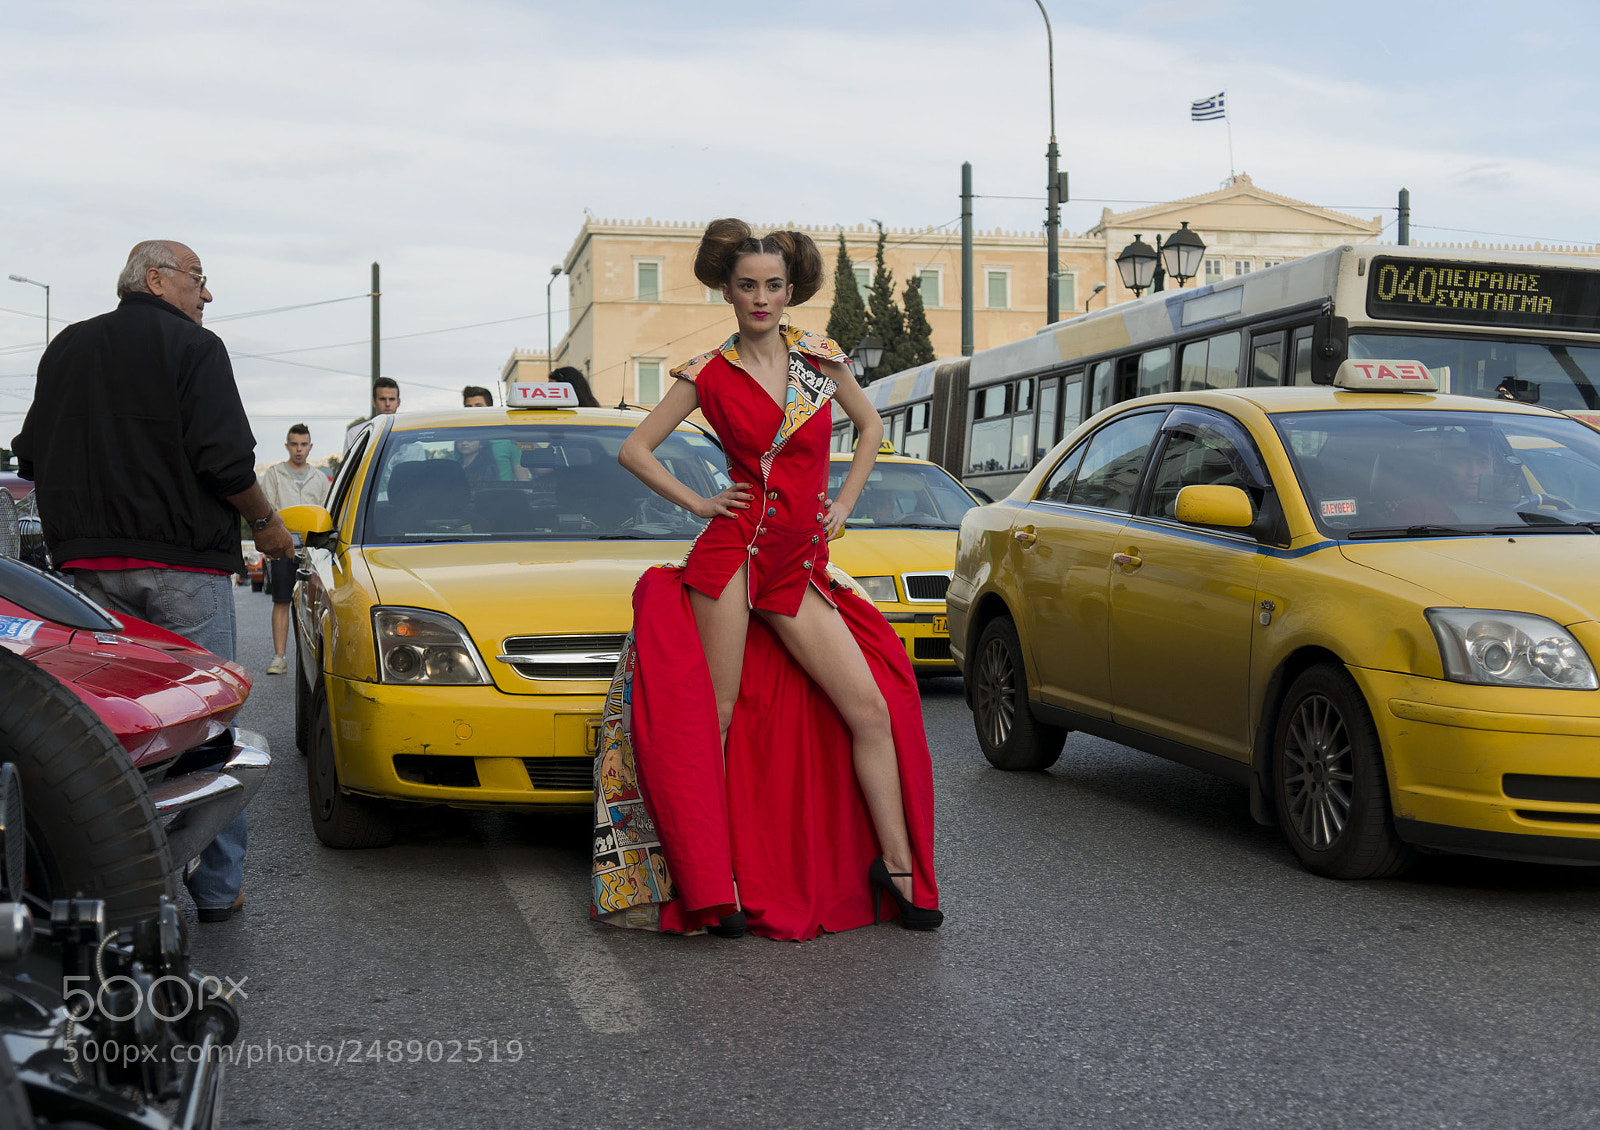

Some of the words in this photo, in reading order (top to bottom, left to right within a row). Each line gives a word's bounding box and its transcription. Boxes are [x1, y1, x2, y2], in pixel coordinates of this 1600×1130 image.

[1377, 264, 1438, 304] 040
[1437, 267, 1541, 293] ΠΕΙΡΑΙΑΣ
[1435, 289, 1553, 314] ΣΥΝΤΑΓΜΑ
[1354, 364, 1429, 381] ΤΑΞΙ
[517, 387, 569, 399] ΤΑΞΙ
[1321, 501, 1356, 515] ΕΛΕΥΘΕΡΟ
